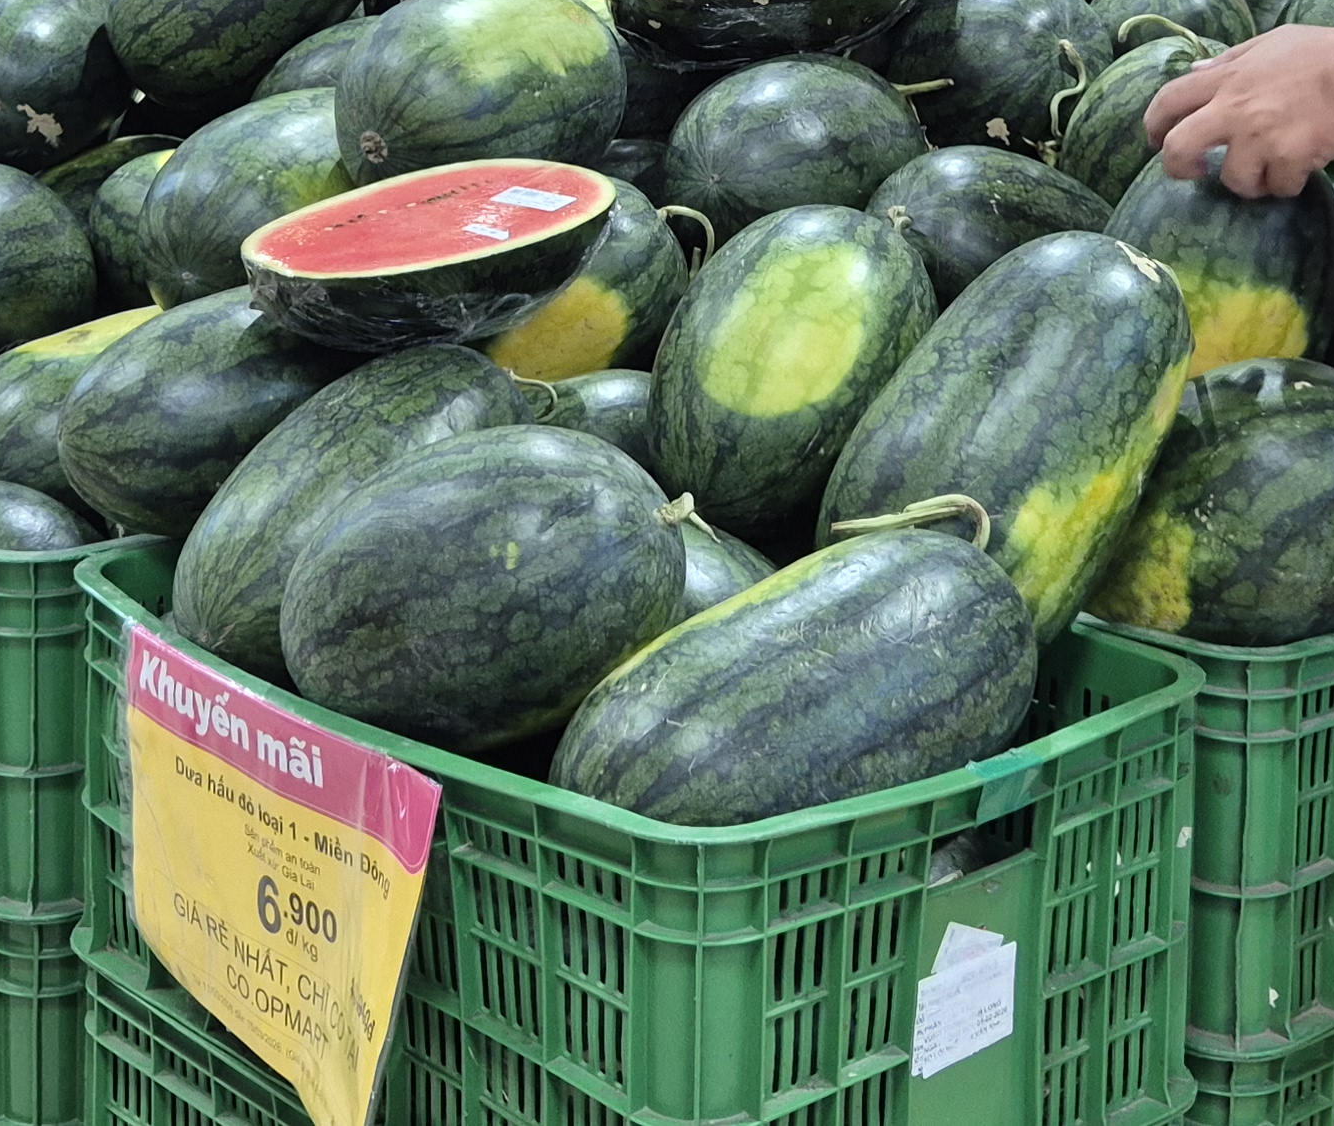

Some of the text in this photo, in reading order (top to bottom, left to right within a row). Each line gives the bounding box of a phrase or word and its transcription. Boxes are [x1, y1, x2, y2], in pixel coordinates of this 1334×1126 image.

[138, 649, 324, 789] Khuyến mãi
[175, 755, 203, 788] Dưa
[207, 774, 234, 803] hấu
[258, 803, 283, 836] loại
[288, 821, 297, 842] 1
[314, 831, 354, 868] Miền
[360, 851, 391, 901] Đông
[173, 892, 203, 932] GIÁ
[205, 916, 230, 951] RẺ
[302, 935, 319, 963] kg
